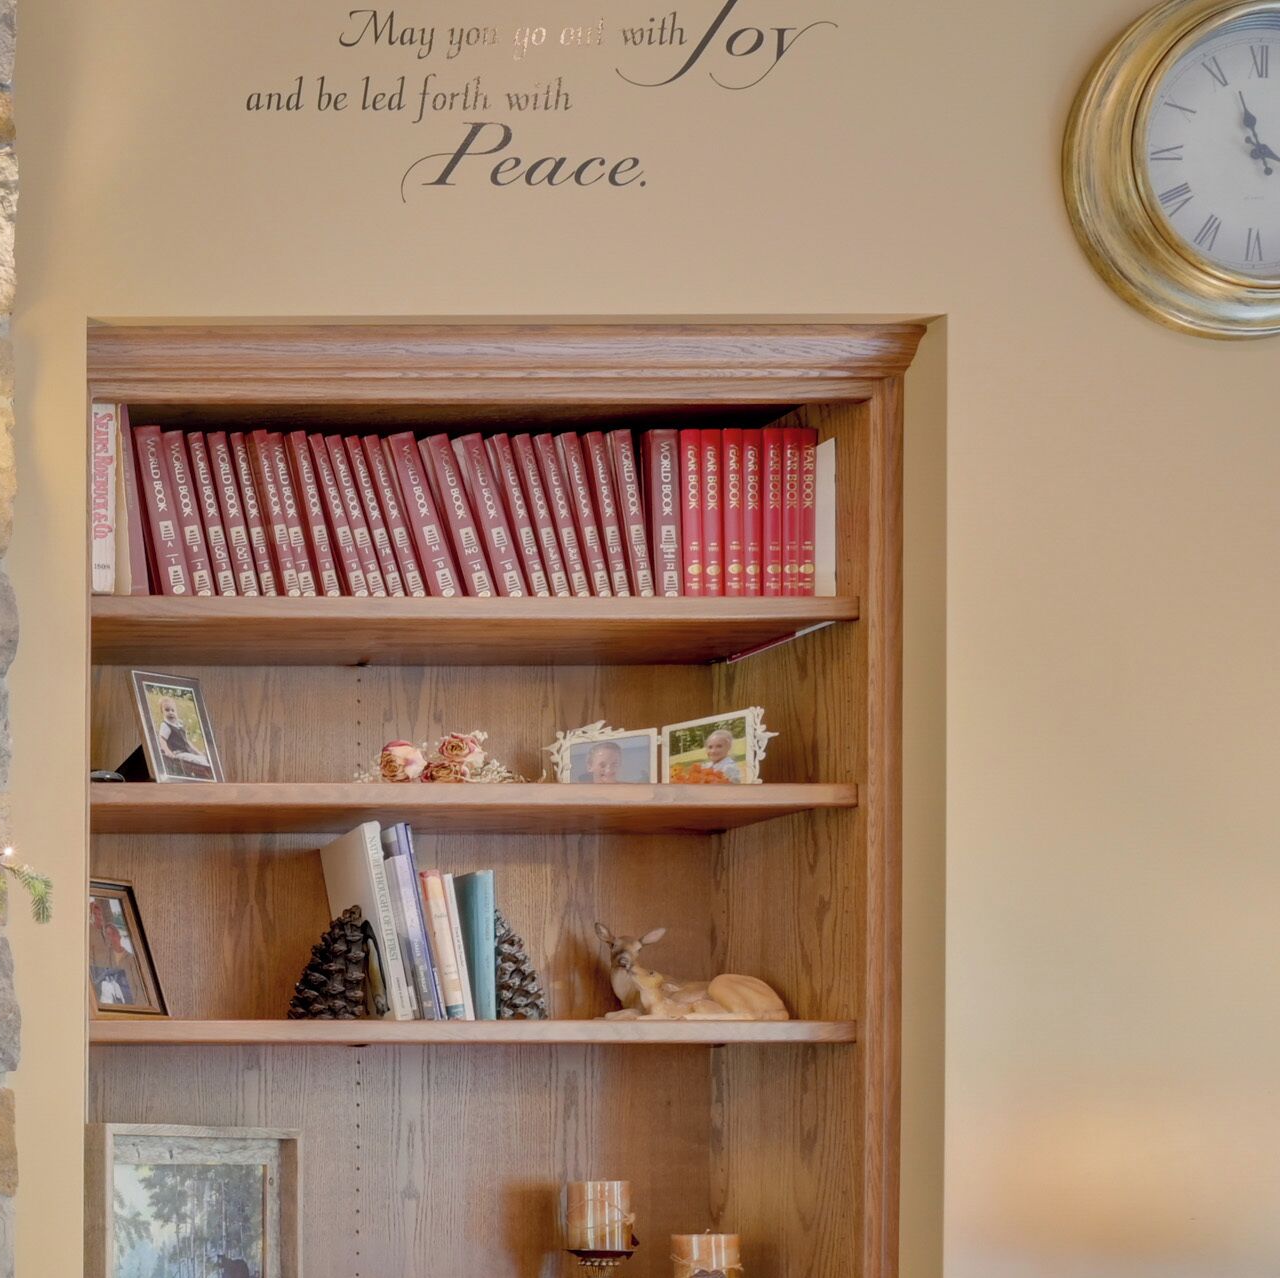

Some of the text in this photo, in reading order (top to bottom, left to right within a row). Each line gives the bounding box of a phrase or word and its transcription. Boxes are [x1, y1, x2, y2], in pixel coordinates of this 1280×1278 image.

[339, 9, 435, 59] May
[446, 24, 498, 59] you
[513, 24, 547, 60] go
[621, 11, 689, 47] with
[246, 73, 573, 123] and be led forth with
[400, 121, 648, 203] Peace.
[146, 437, 167, 512] WORLD BOOK
[170, 443, 193, 517] WORLD BOOK
[192, 442, 217, 517] WORLD BOOK
[216, 444, 239, 518] WORLD BOOK
[274, 444, 297, 518] WORLD BOOK
[298, 443, 321, 518] WORLD BOOK
[402, 444, 430, 517] WORLD BOOK
[440, 447, 467, 519] WORLD BOOK
[620, 441, 640, 516] WORLD BOOK
[660, 441, 673, 516] WORLD BOOK
[688, 475, 699, 510] BOOK
[707, 476, 718, 510] BOOK
[729, 474, 740, 509] BOOK
[748, 475, 758, 509] BOOK
[770, 474, 780, 509] BOOK
[787, 474, 798, 509] BOOK
[803, 443, 814, 508] YEAR BOOK
[245, 487, 259, 518] BOOK
[345, 488, 361, 519] BOOK
[365, 490, 381, 520] BOOK
[384, 489, 400, 519] BOOK
[383, 915, 392, 927] OF
[386, 937, 398, 962] FIRST
